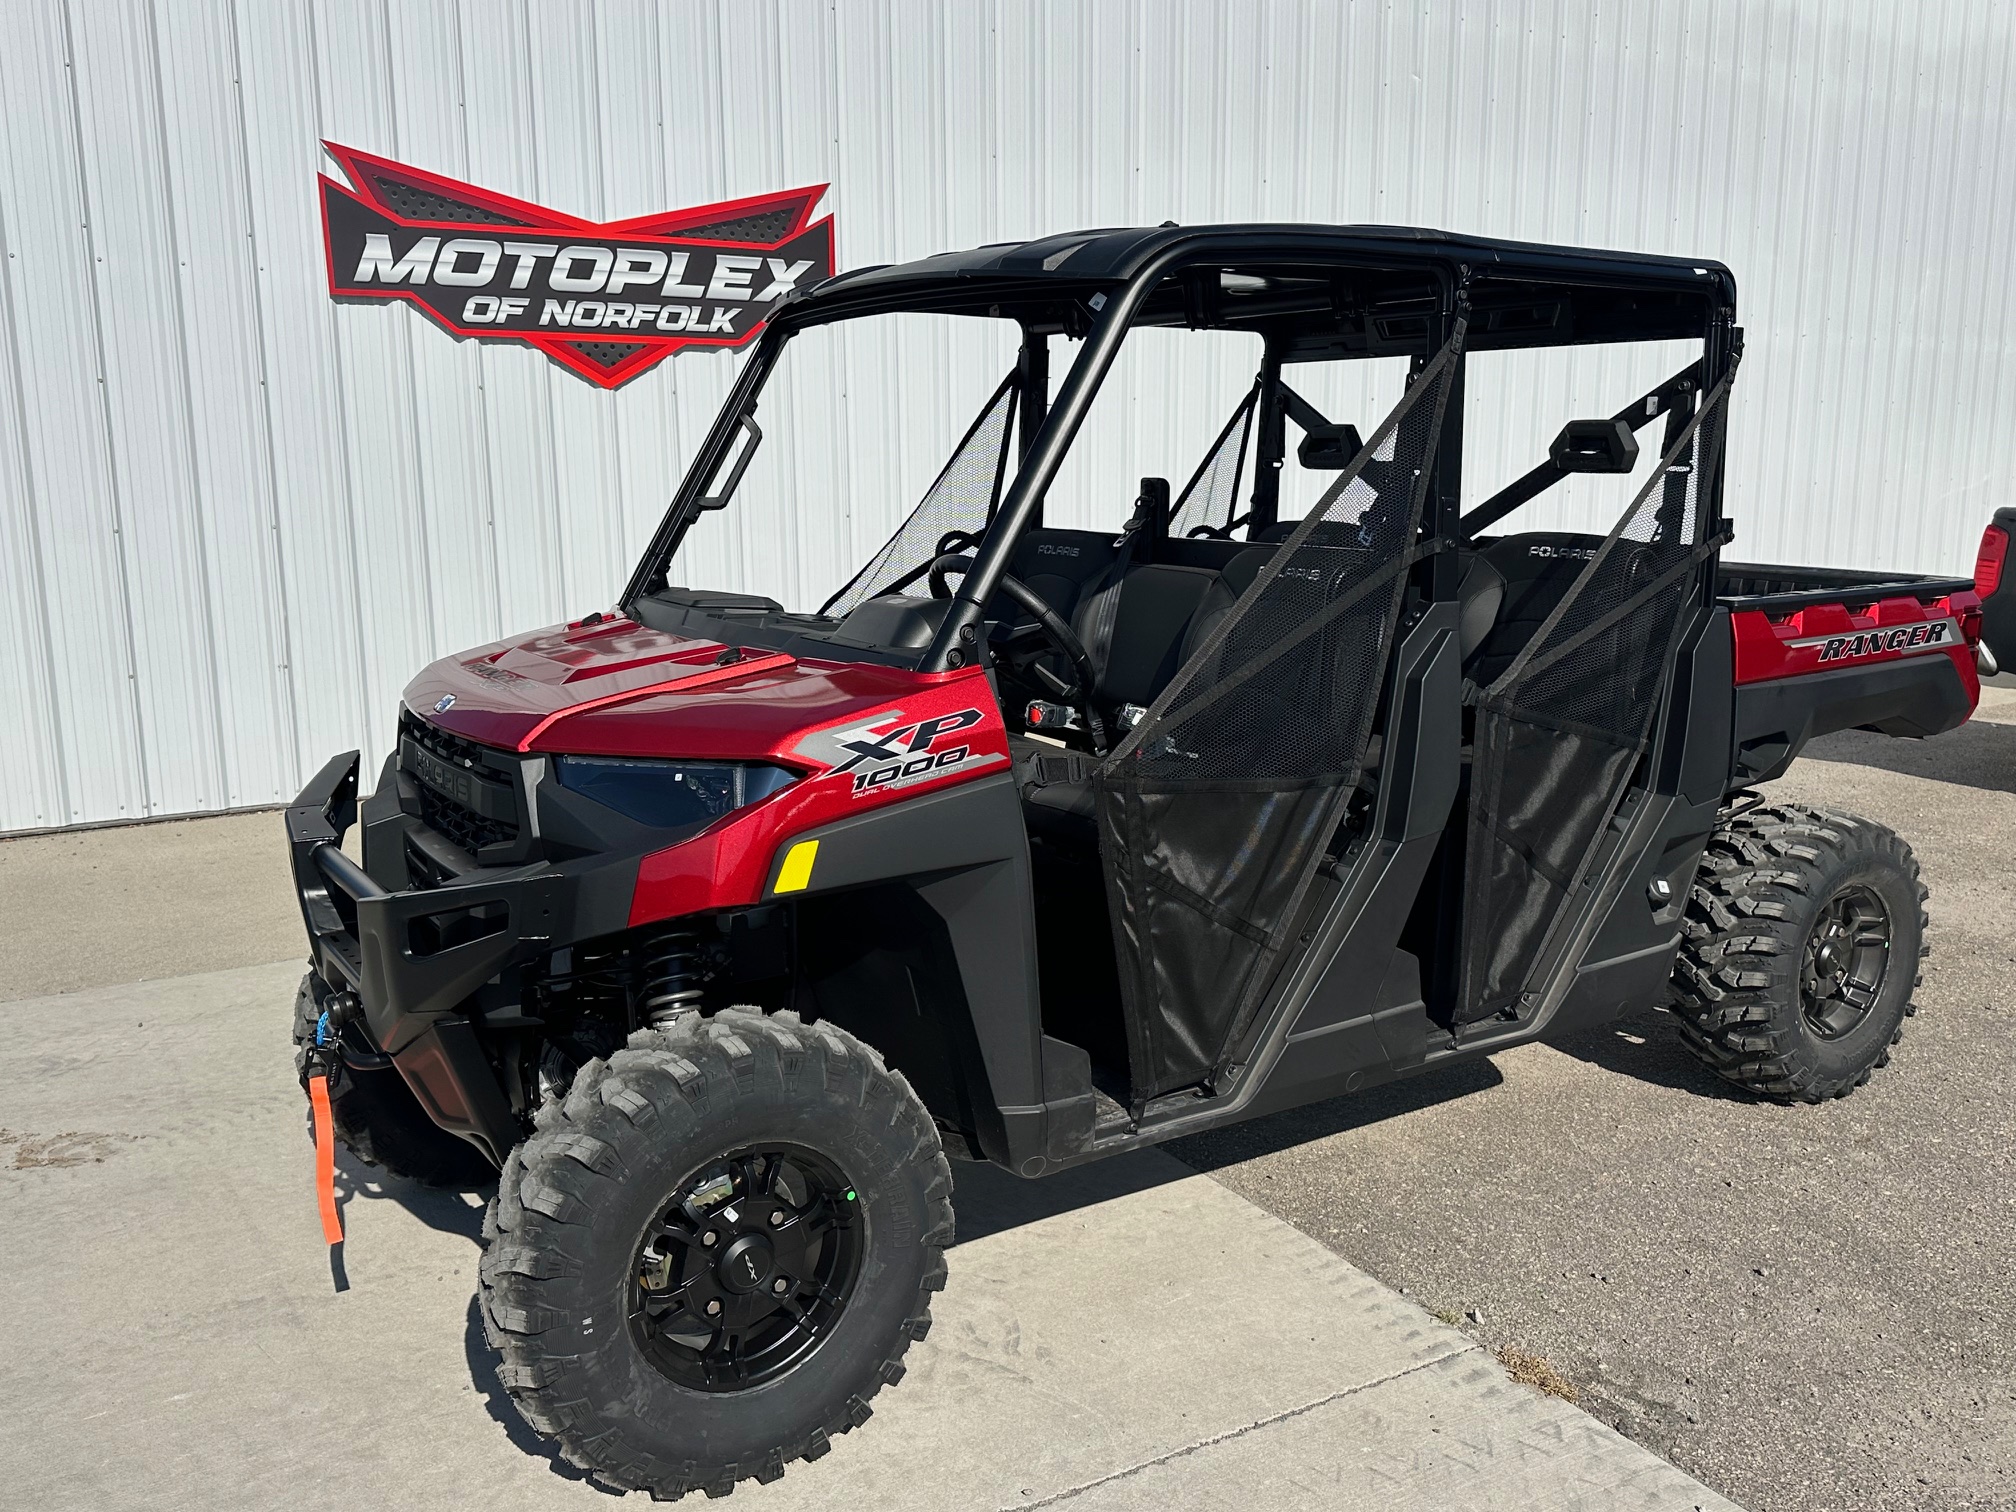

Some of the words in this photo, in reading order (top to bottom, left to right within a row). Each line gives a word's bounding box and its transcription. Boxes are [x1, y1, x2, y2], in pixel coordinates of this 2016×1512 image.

[353, 233, 815, 302] MOTOPLEX
[462, 296, 530, 325] OF
[539, 301, 742, 333] NORFOLK
[1037, 544, 1080, 557] POLARIS
[1528, 546, 1597, 560] POLARIS
[1818, 621, 1948, 663] RANGER
[813, 707, 986, 782] XP
[417, 750, 469, 802] POLARIS
[851, 744, 970, 793] 1000
[852, 787, 880, 800] DUAL
[882, 771, 938, 791] OVERHEAD
[940, 763, 964, 776] CAM
[744, 1253, 758, 1281] XP
